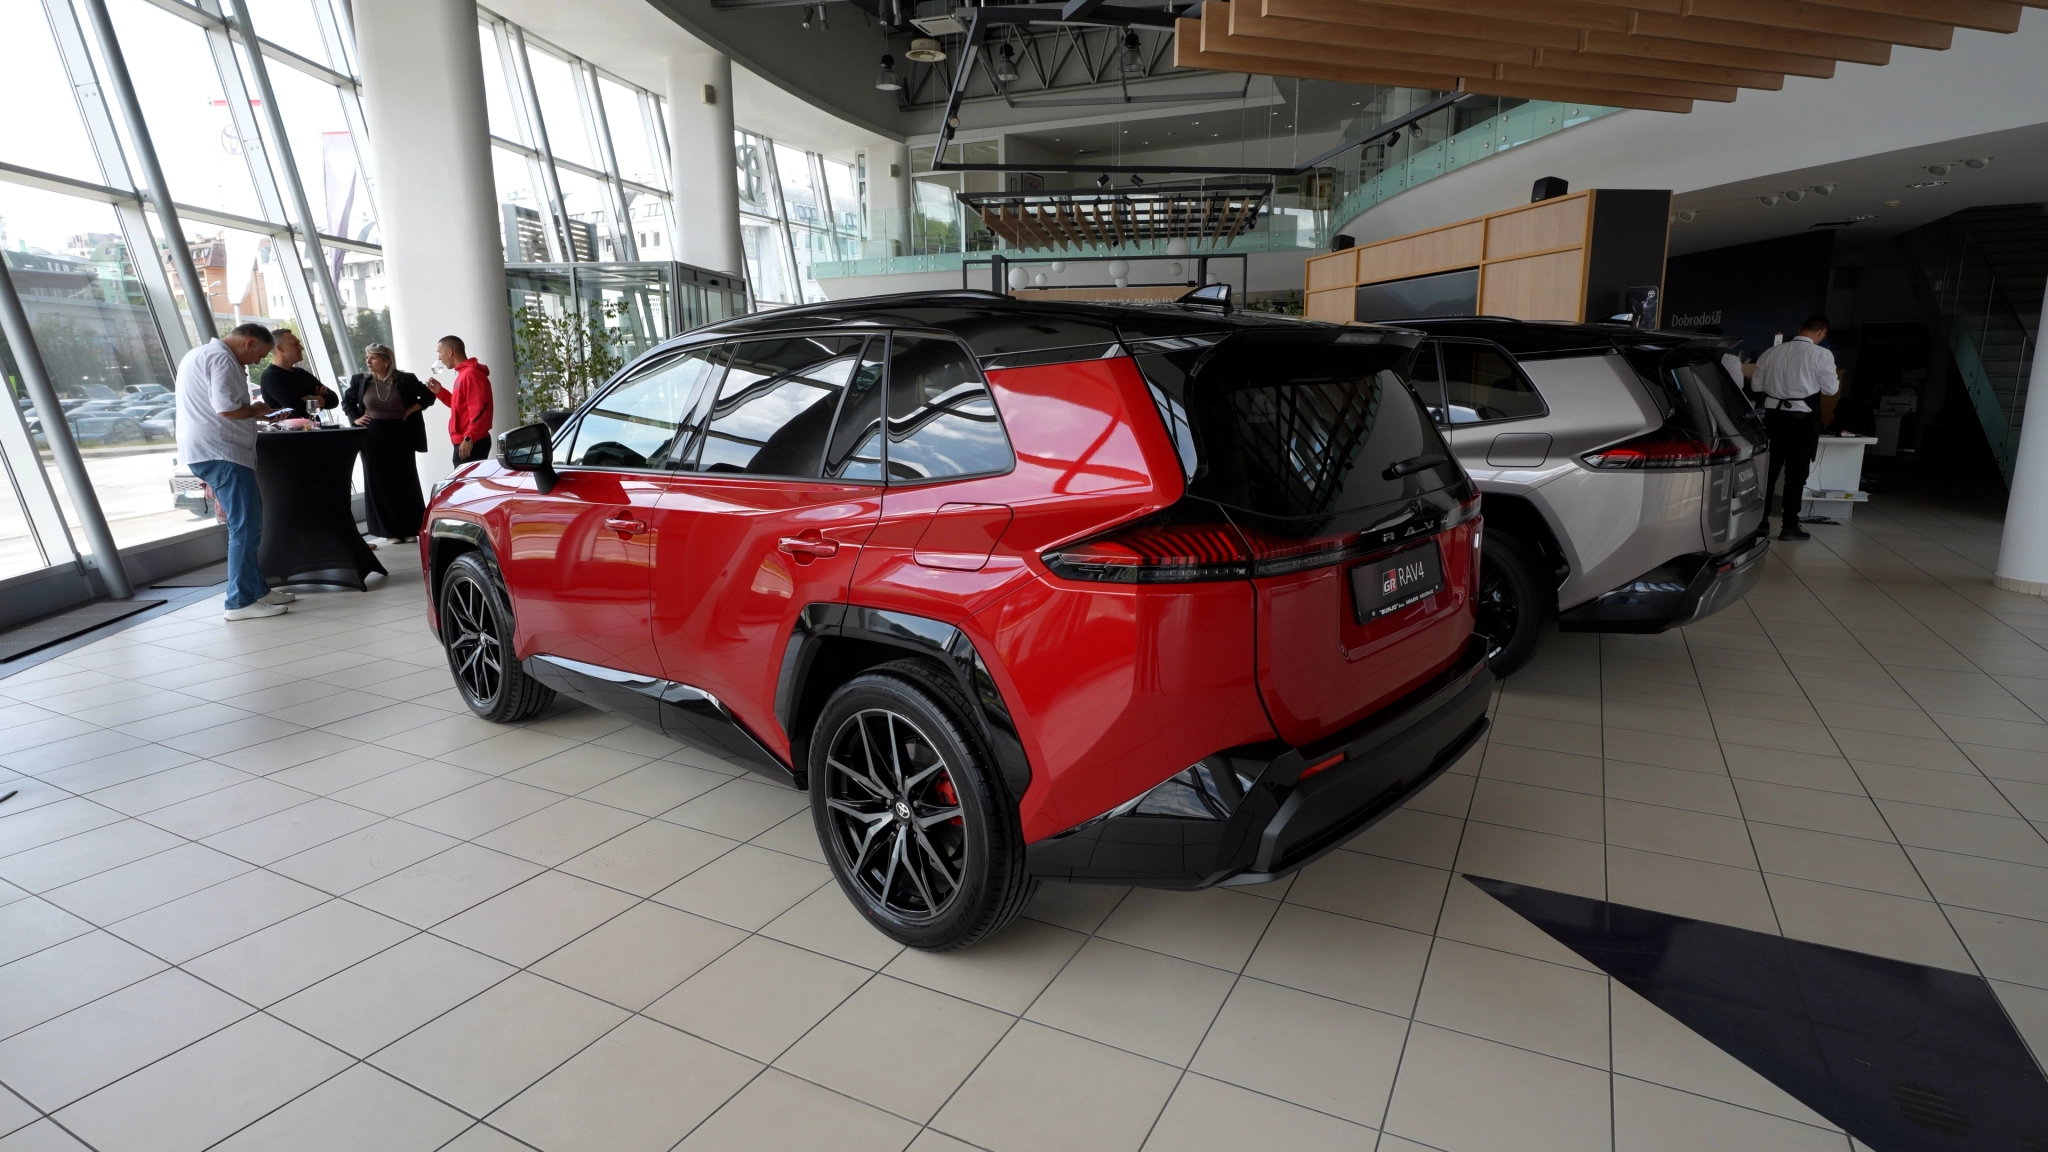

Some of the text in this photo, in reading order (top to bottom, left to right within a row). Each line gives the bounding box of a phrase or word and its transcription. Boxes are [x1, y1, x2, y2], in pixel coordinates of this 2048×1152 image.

[1671, 310, 1722, 327] Dobrodošli
[1383, 561, 1424, 593] GR RAV4
[957, 884, 980, 926] TOYO
